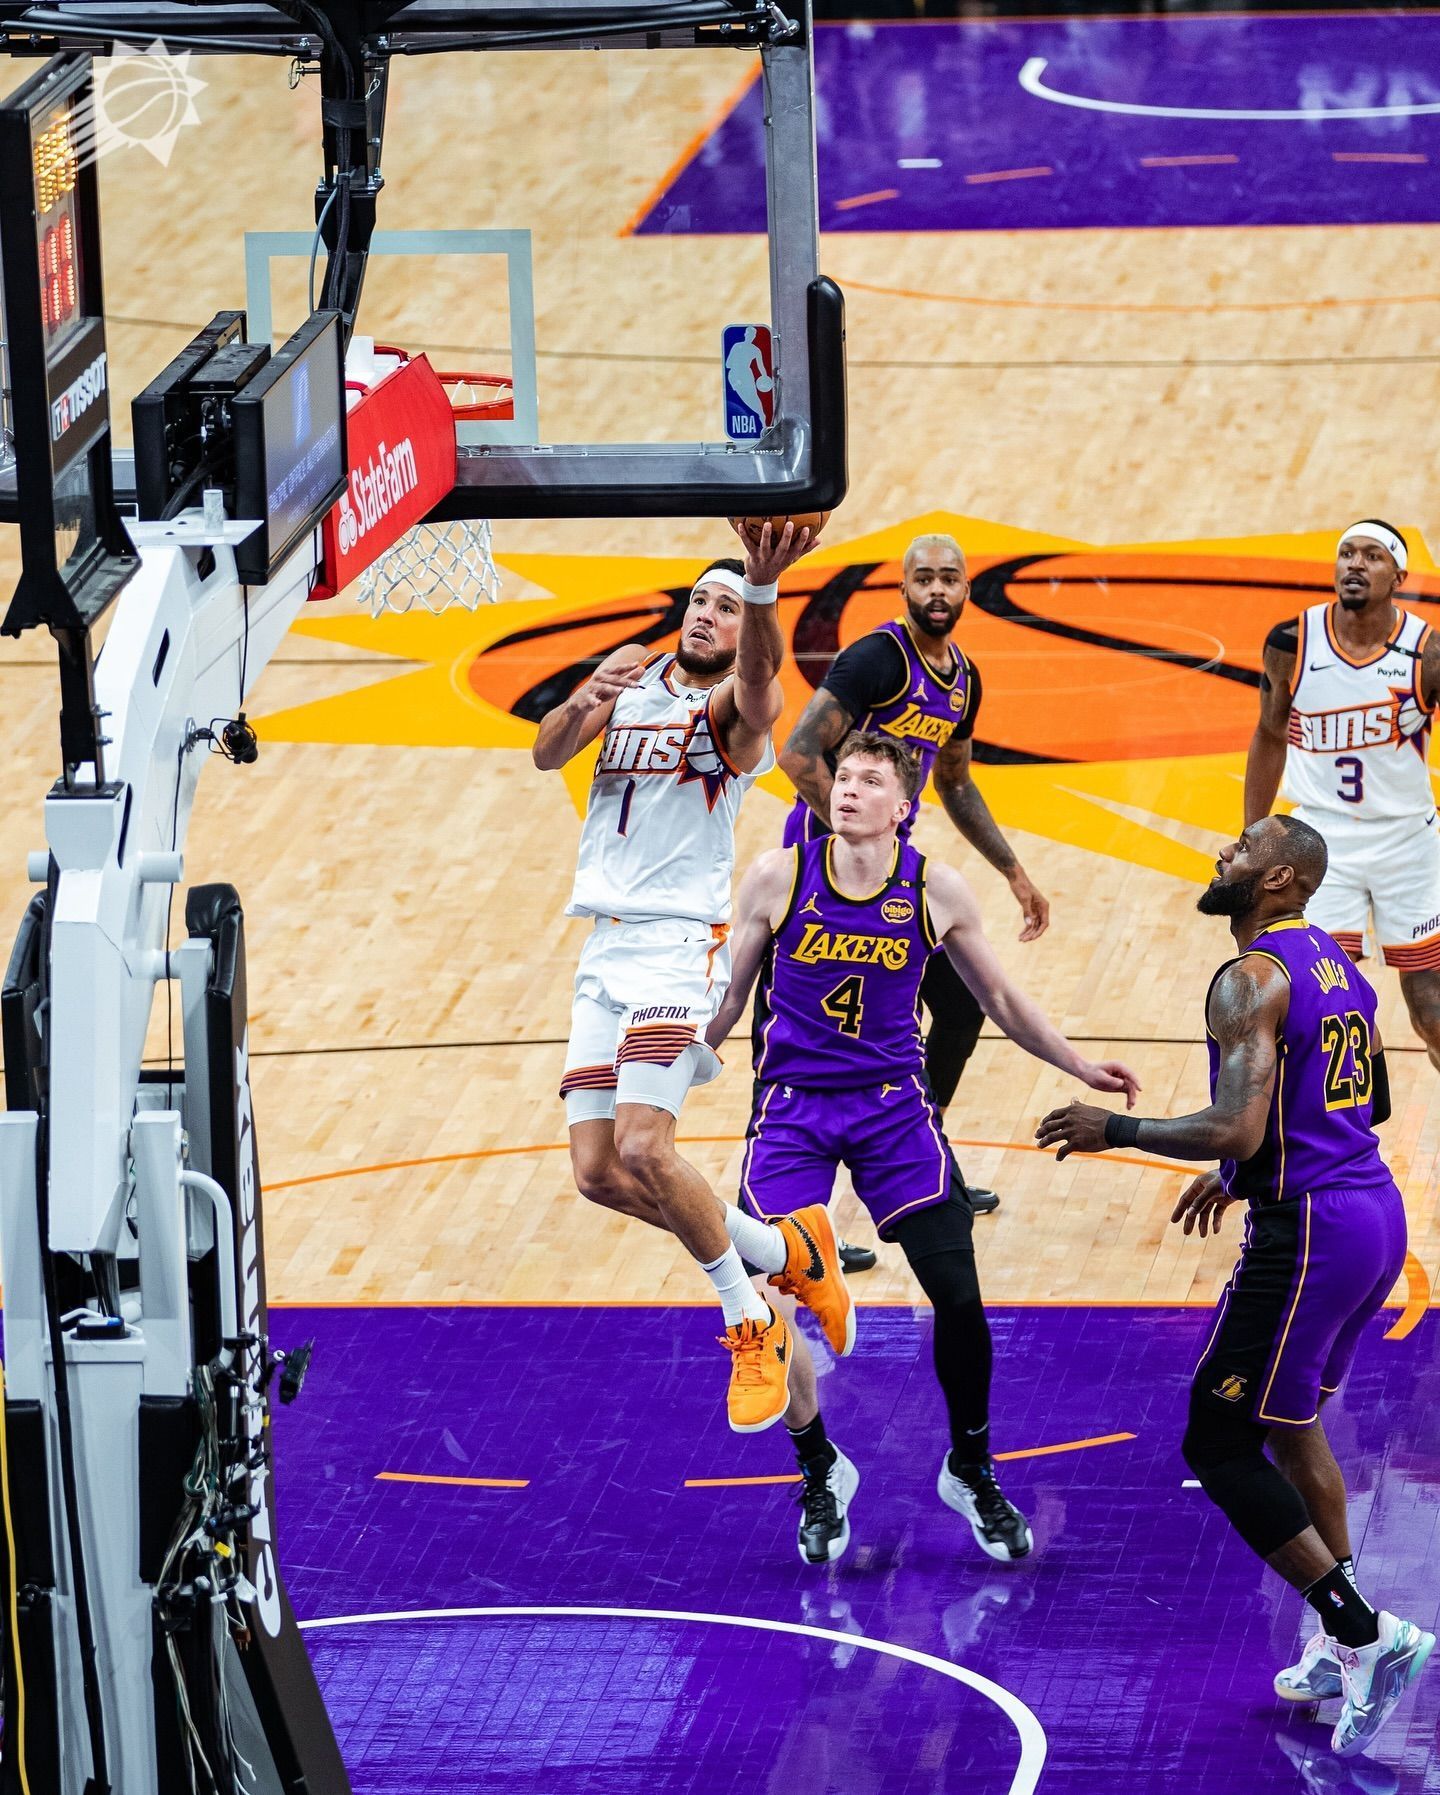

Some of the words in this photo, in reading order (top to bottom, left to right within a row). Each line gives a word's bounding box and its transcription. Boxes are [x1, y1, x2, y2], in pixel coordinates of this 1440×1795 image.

[69, 352, 107, 423] TISSOT
[732, 415, 757, 434] NBA
[1377, 667, 1407, 678] PayPal
[595, 728, 686, 773] UNS
[1300, 705, 1393, 752] SUNS
[1335, 756, 1363, 804] 3
[616, 778, 637, 838] 1
[884, 904, 912, 917] bibigo
[789, 923, 911, 971] LAKERS
[1310, 957, 1349, 994] JAMES
[631, 1006, 691, 1025] PHOENIX
[820, 975, 865, 1039] 4
[1321, 1010, 1373, 1113] 23
